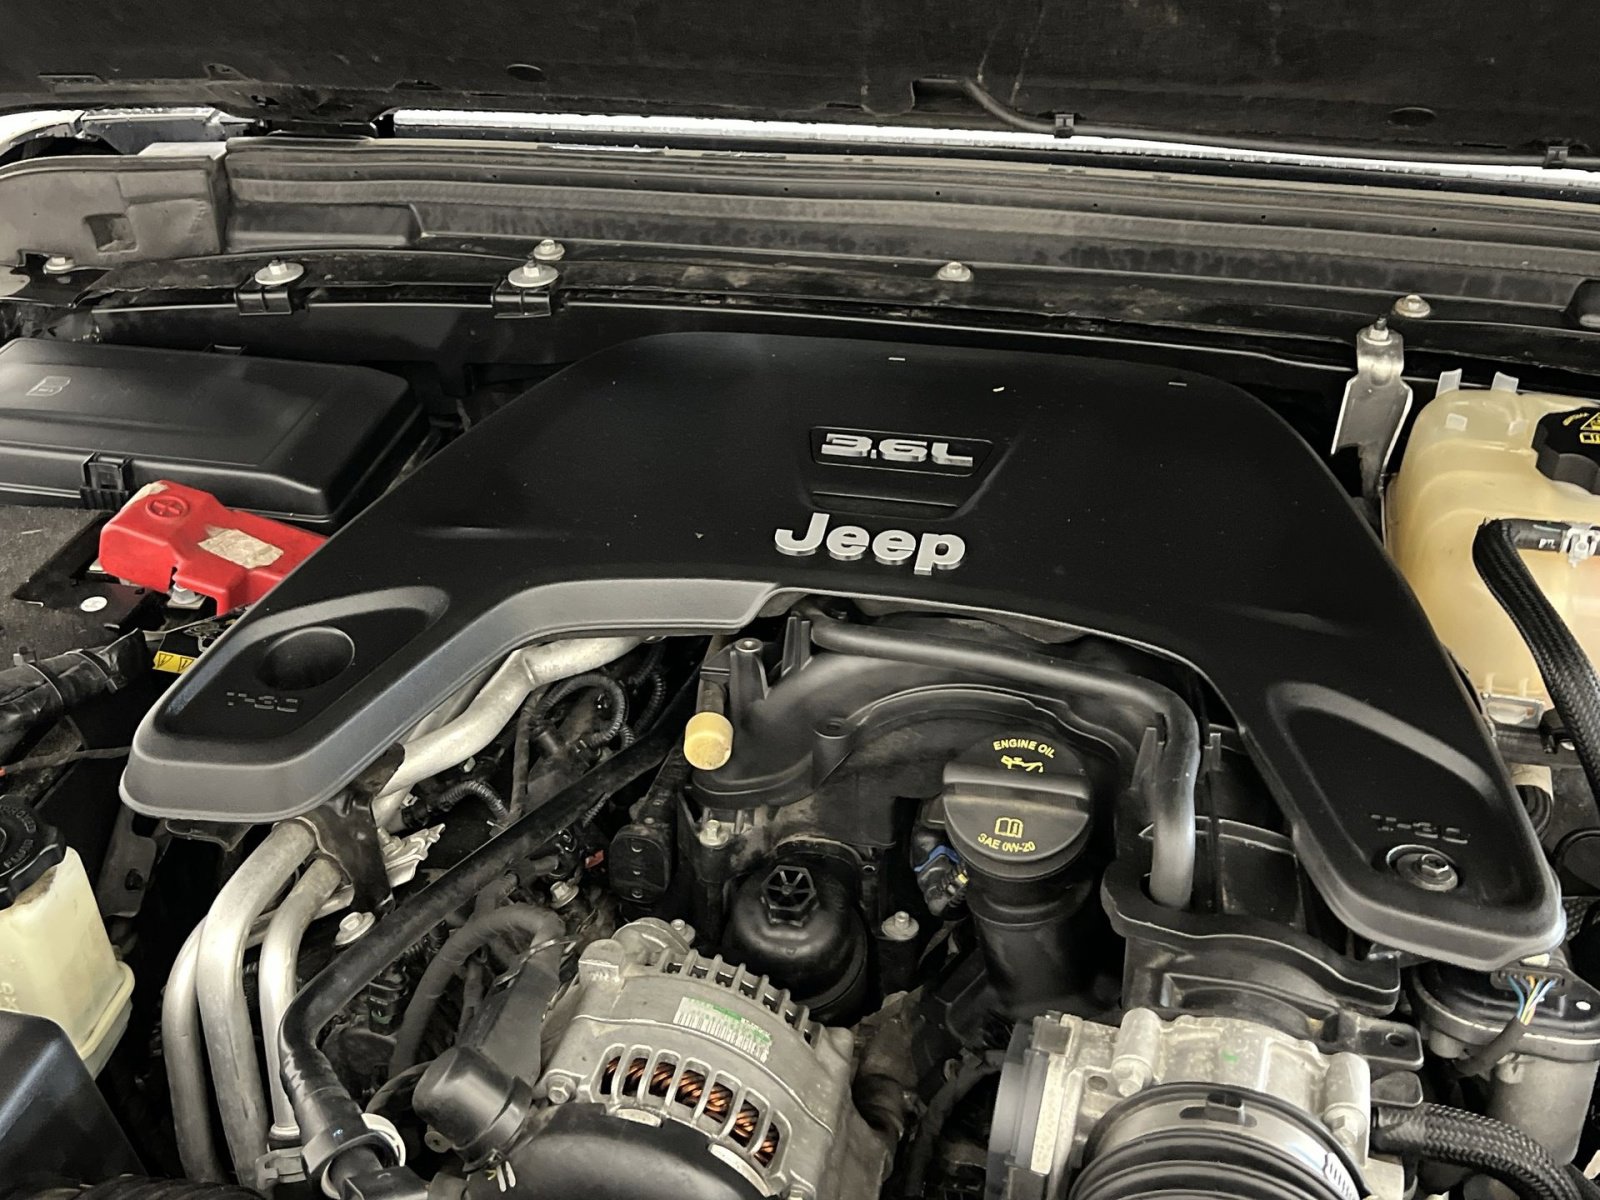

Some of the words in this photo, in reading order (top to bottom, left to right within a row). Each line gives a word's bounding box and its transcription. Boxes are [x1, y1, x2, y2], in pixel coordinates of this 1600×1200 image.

[821, 433, 973, 467] 3.6L
[774, 512, 966, 576] Jeep
[993, 739, 1037, 751] ENGINE
[1037, 744, 1055, 759] OIL
[977, 833, 1000, 850] SAE
